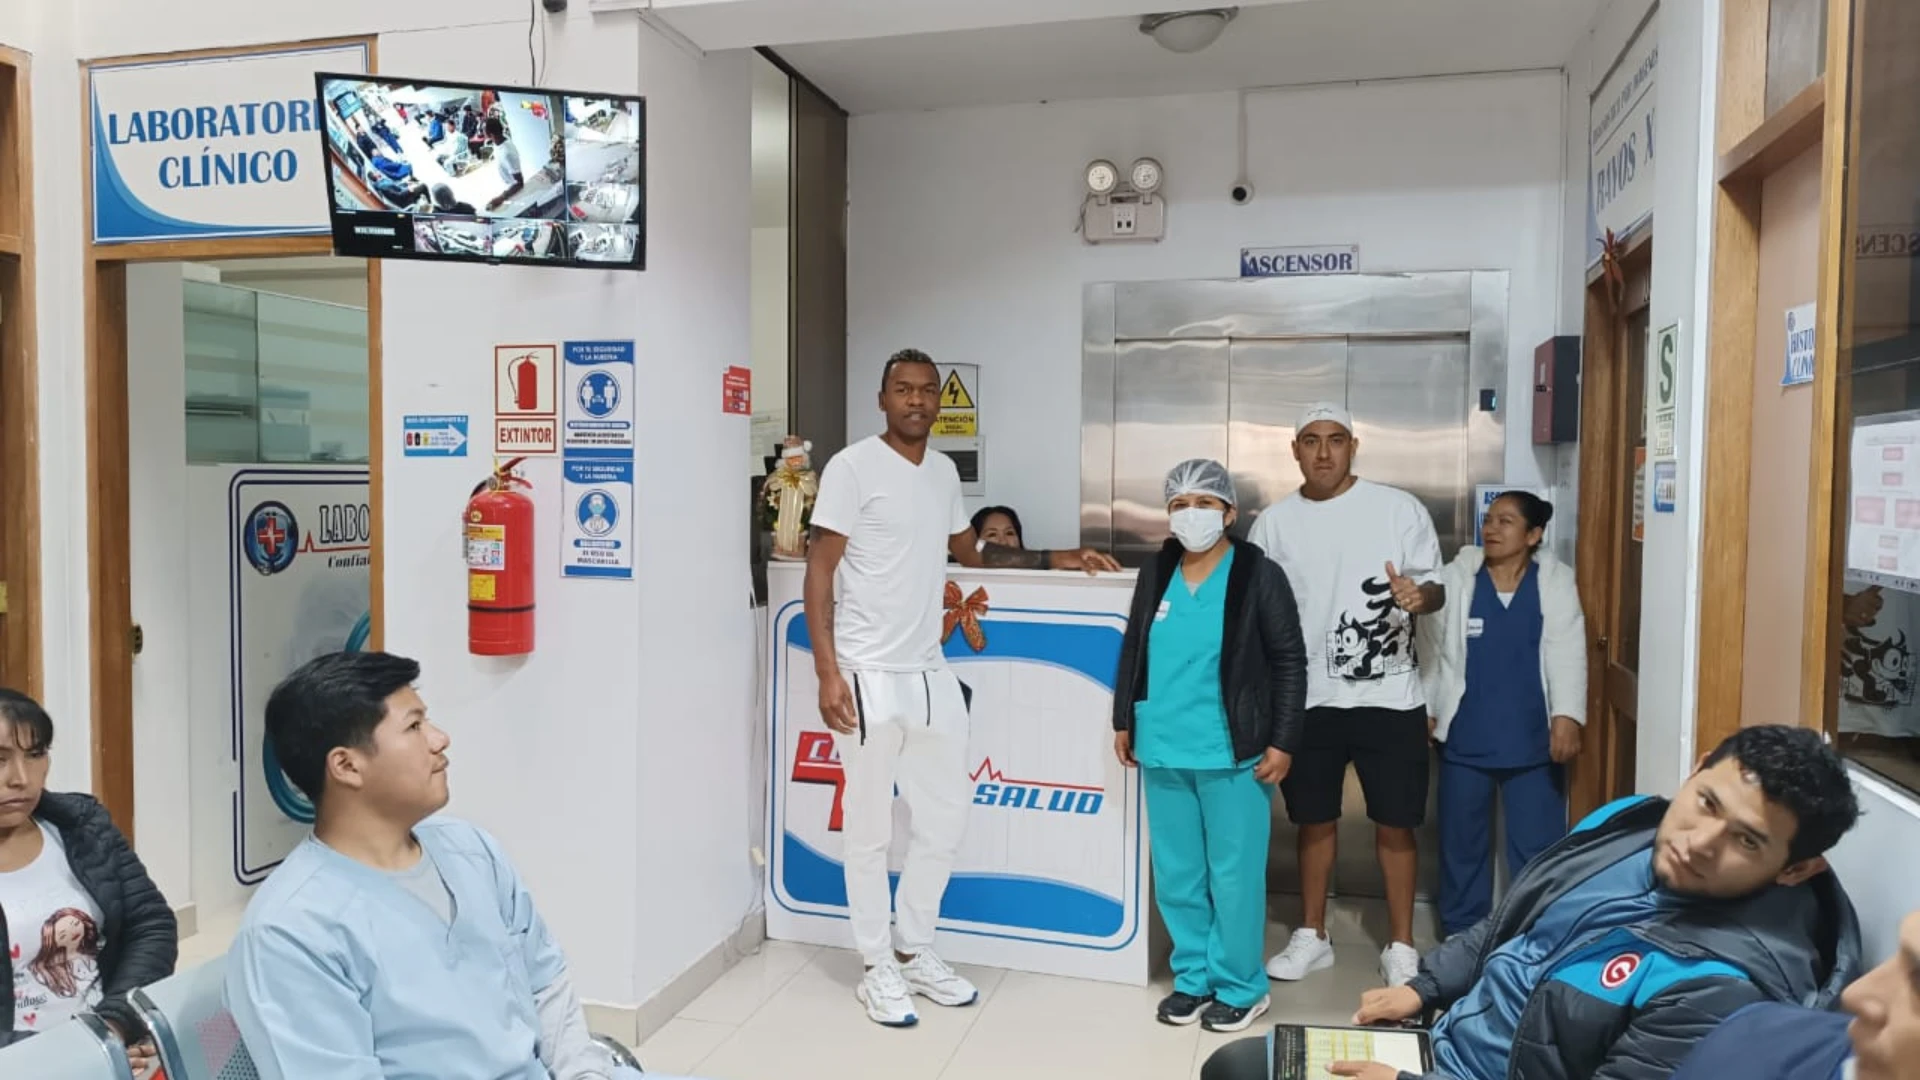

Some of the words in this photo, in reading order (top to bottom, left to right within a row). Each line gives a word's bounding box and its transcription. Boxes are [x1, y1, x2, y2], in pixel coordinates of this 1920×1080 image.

[158, 146, 298, 189] CLÍNICO
[1596, 131, 1636, 215] RAYOS
[1247, 252, 1353, 275] ASCENSOR
[1659, 333, 1674, 404] S
[500, 427, 552, 443] EXTINTOR
[320, 503, 369, 543] LABO
[973, 783, 1104, 815] SALUD
